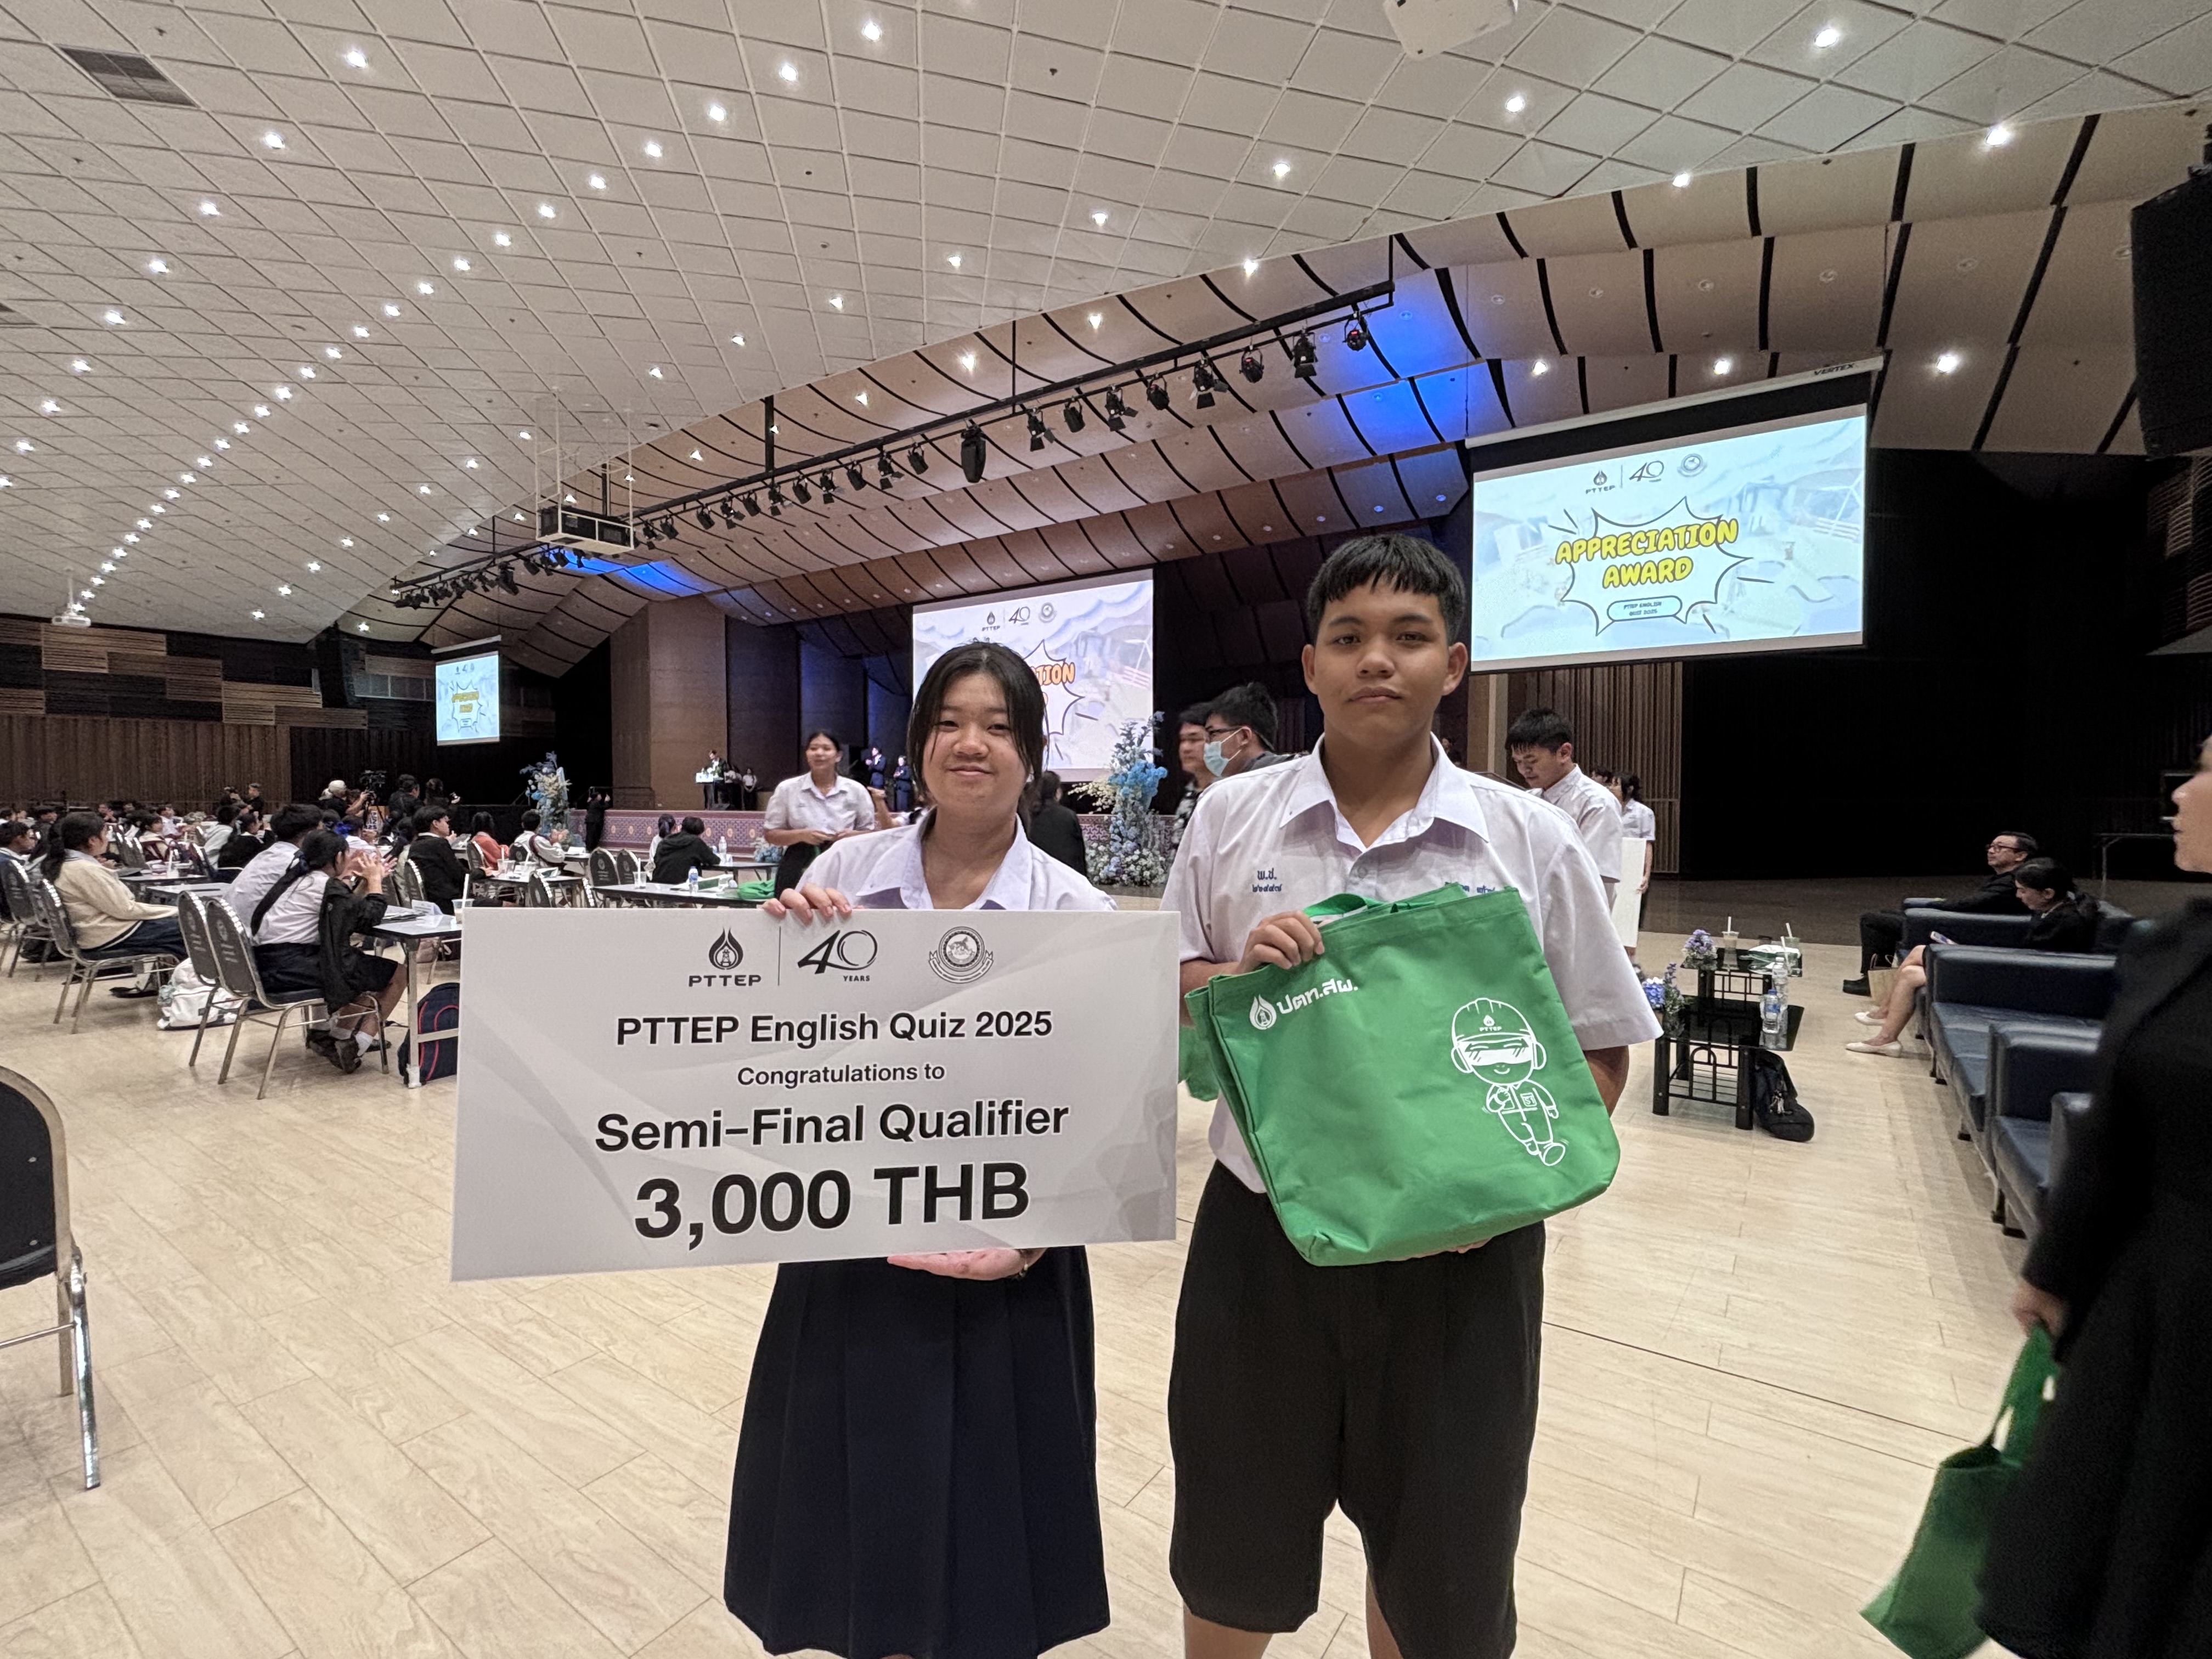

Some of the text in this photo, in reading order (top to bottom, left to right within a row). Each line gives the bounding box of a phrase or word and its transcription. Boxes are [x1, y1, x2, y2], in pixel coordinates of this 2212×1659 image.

[1585, 485, 1615, 494] PTTEP
[1555, 518, 1739, 565] APPRECIATION
[1602, 556, 1694, 589] AWARD
[798, 930, 878, 974] 40
[689, 974, 761, 987] PTTEP
[1276, 978, 1358, 1014] ปตท.สผ.
[617, 1011, 1052, 1049] PTTEP English Quiz 2025
[737, 1064, 945, 1089] Congratulations to
[879, 1099, 1069, 1144] Qualifier
[635, 1163, 1029, 1250] 3,000 THB
